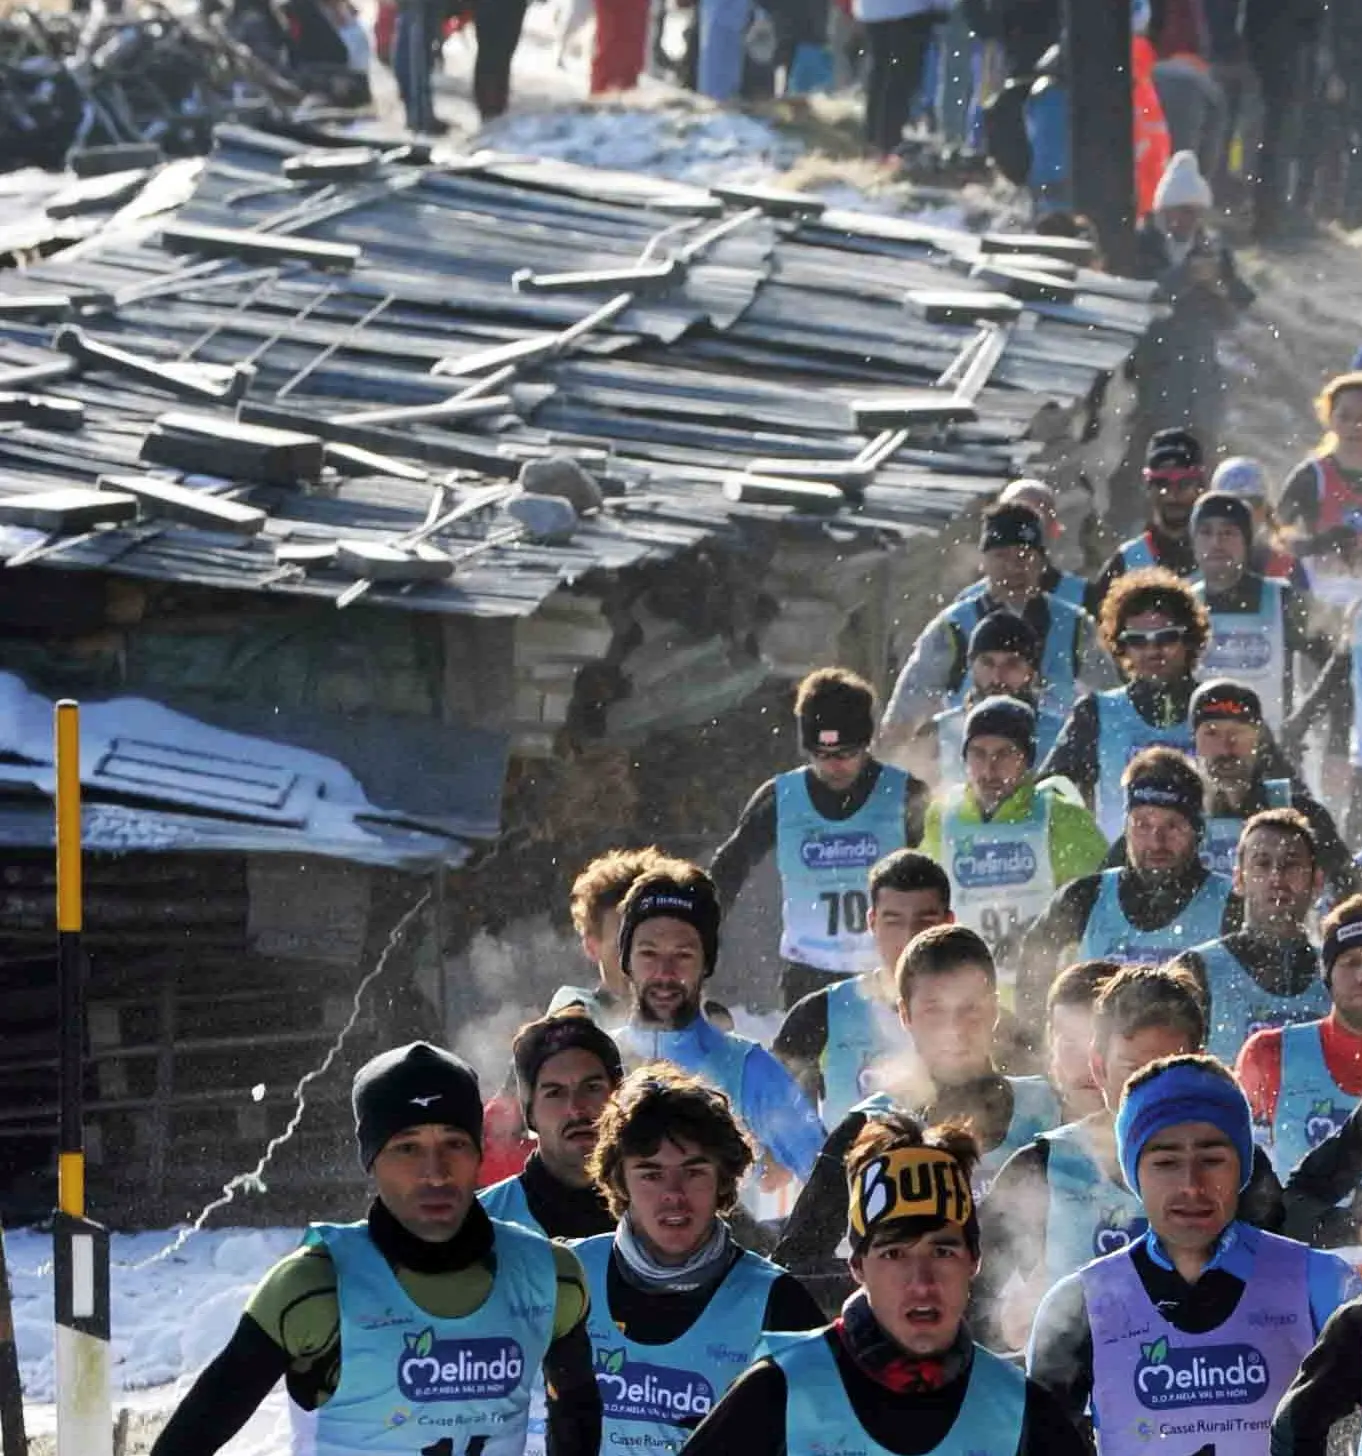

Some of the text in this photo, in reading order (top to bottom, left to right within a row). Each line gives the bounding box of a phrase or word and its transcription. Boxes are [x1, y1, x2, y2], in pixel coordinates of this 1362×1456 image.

[820, 889, 868, 936] 70
[402, 1349, 522, 1385] Melinda
[1138, 1355, 1266, 1393] Melinda
[596, 1374, 711, 1414] Melinda
